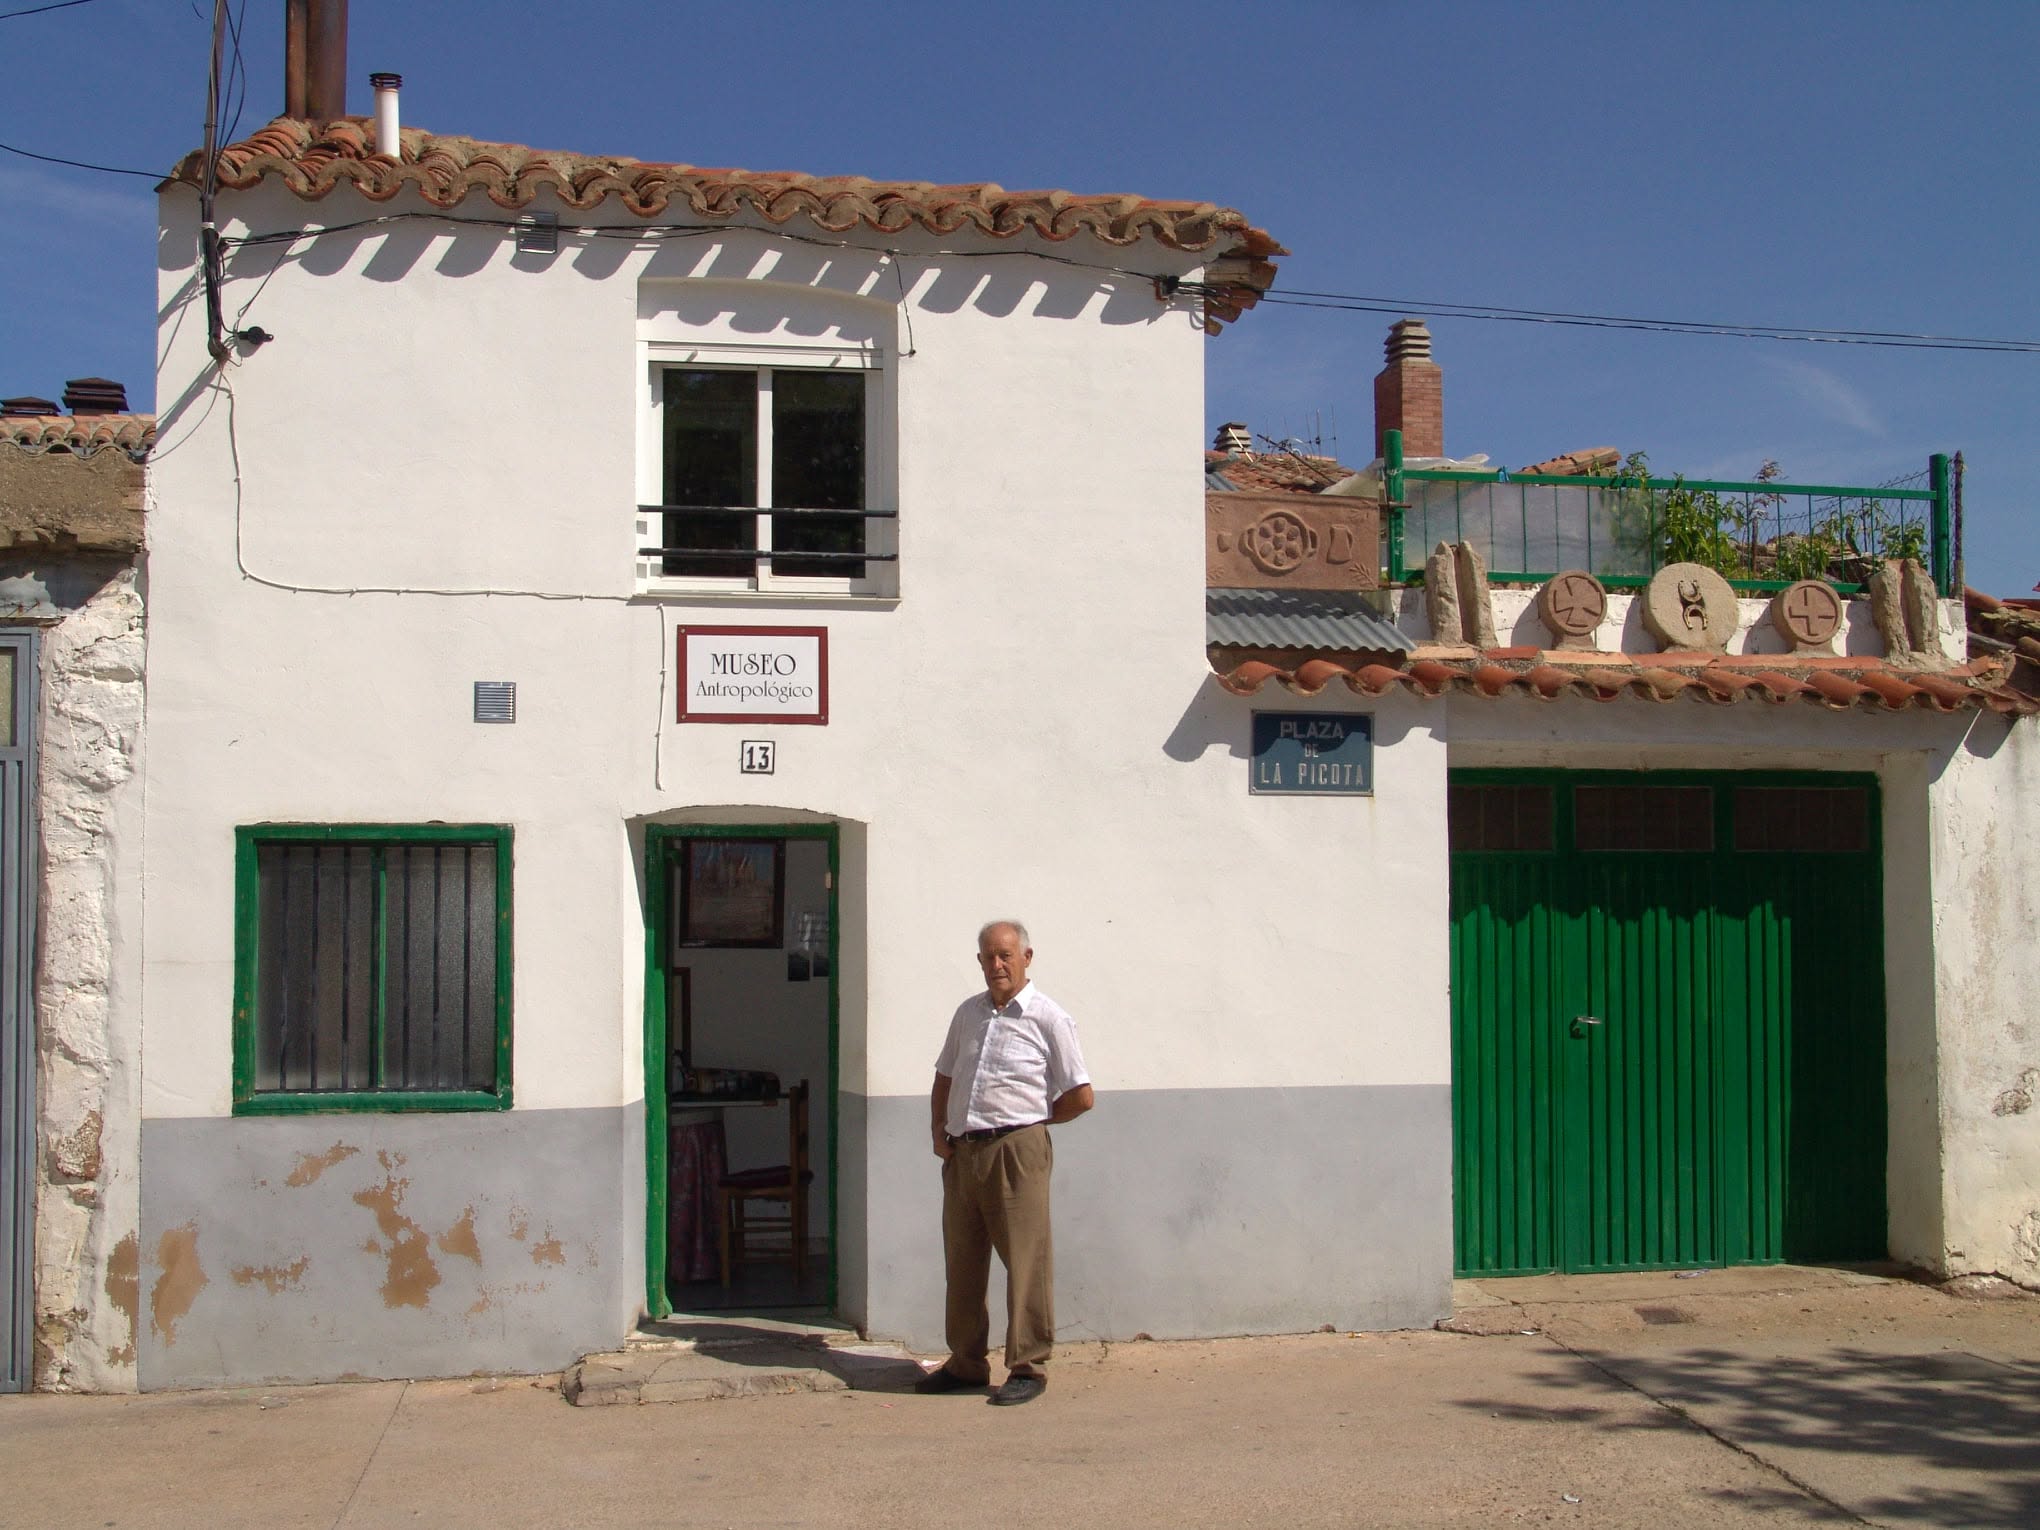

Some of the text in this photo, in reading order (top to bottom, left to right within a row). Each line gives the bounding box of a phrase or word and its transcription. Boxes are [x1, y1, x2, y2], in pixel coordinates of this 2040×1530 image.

[710, 653, 796, 676] MUSEO
[696, 681, 813, 703] Antropológico
[1280, 720, 1344, 739] PLAZA
[745, 746, 770, 770] 13
[1304, 743, 1319, 758] DE
[1261, 762, 1364, 785] LA PICOTA
